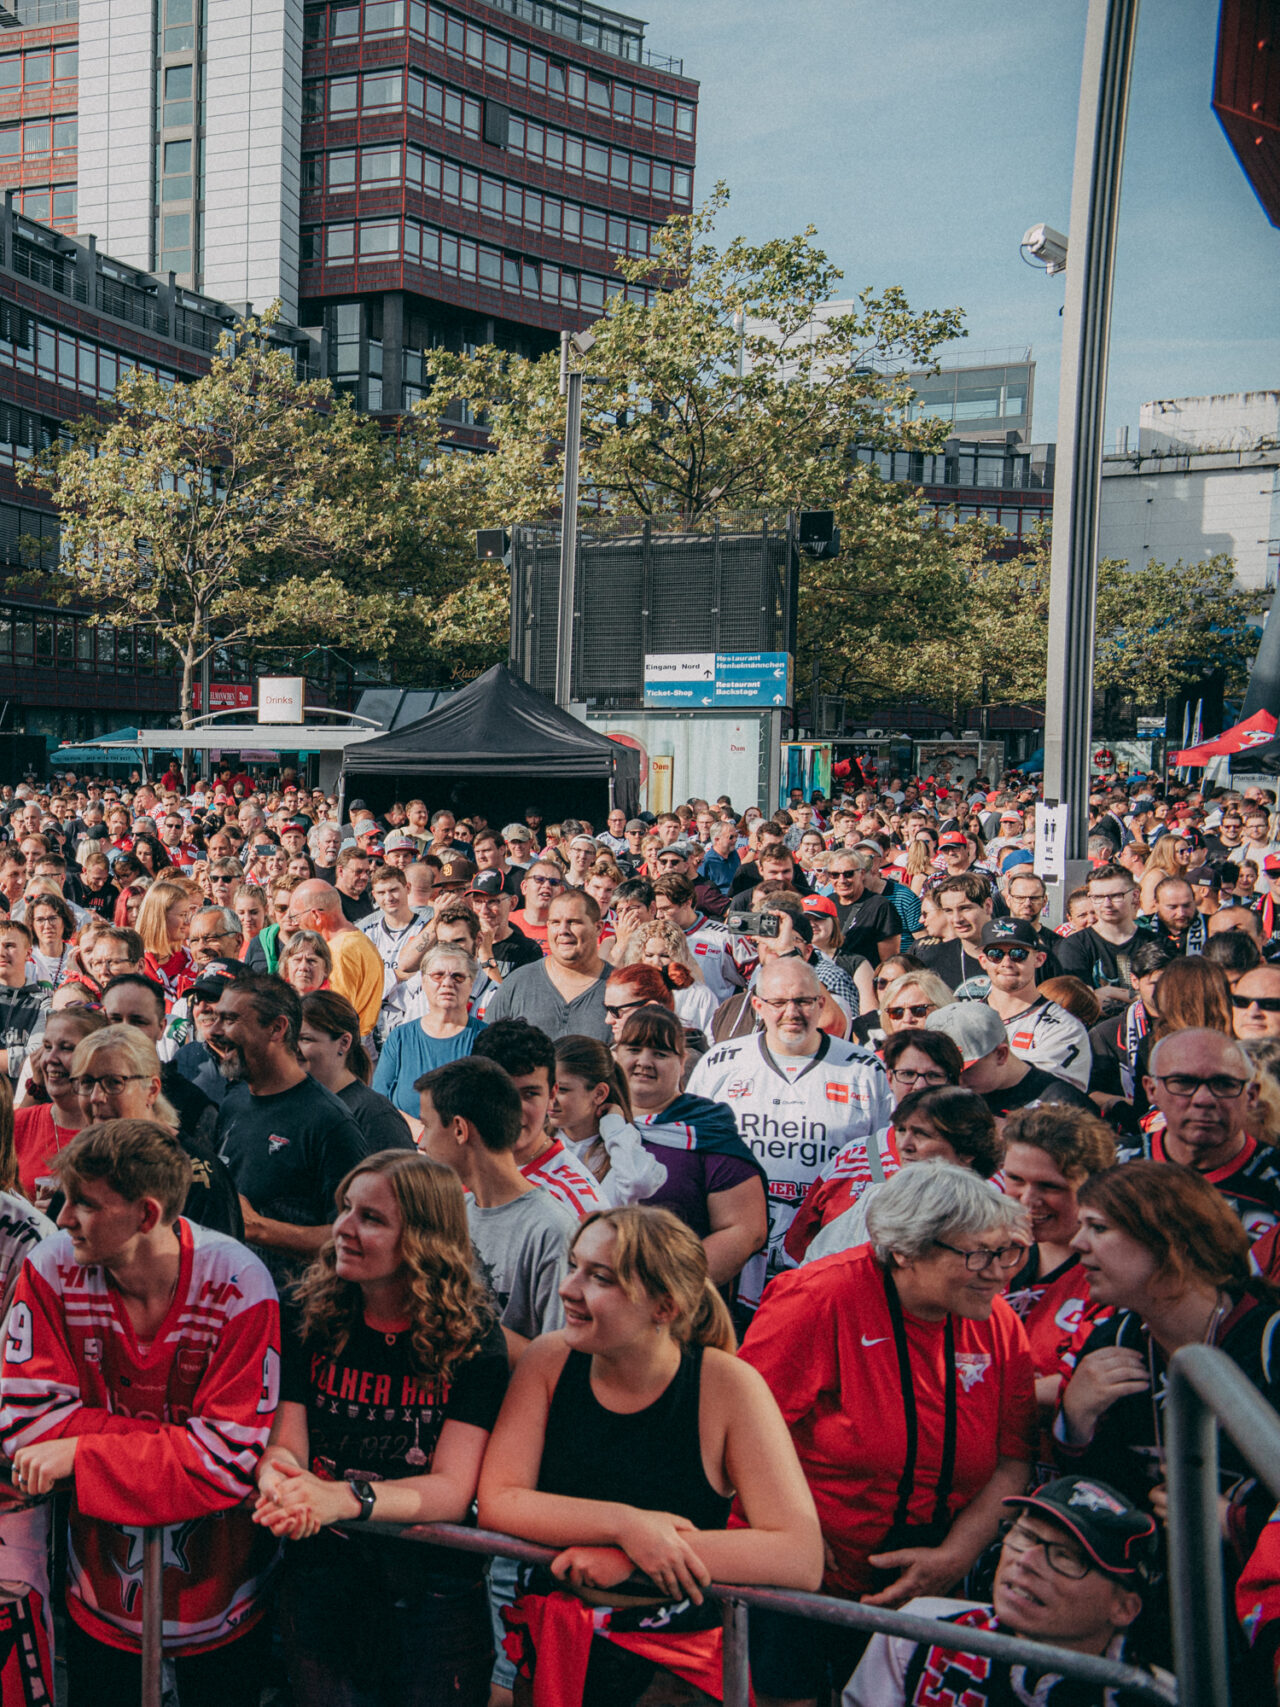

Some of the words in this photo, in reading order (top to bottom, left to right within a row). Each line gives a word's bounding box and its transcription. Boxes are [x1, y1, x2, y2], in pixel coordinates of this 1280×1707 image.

[266, 696, 294, 704] Drinks
[731, 744, 746, 752] Dom
[652, 762, 669, 771] Dom
[707, 1046, 742, 1068] HIT
[740, 1113, 827, 1141] Rhein
[552, 1164, 599, 1203] HIT
[769, 1182, 796, 1196] NER
[6, 1300, 34, 1364] 9
